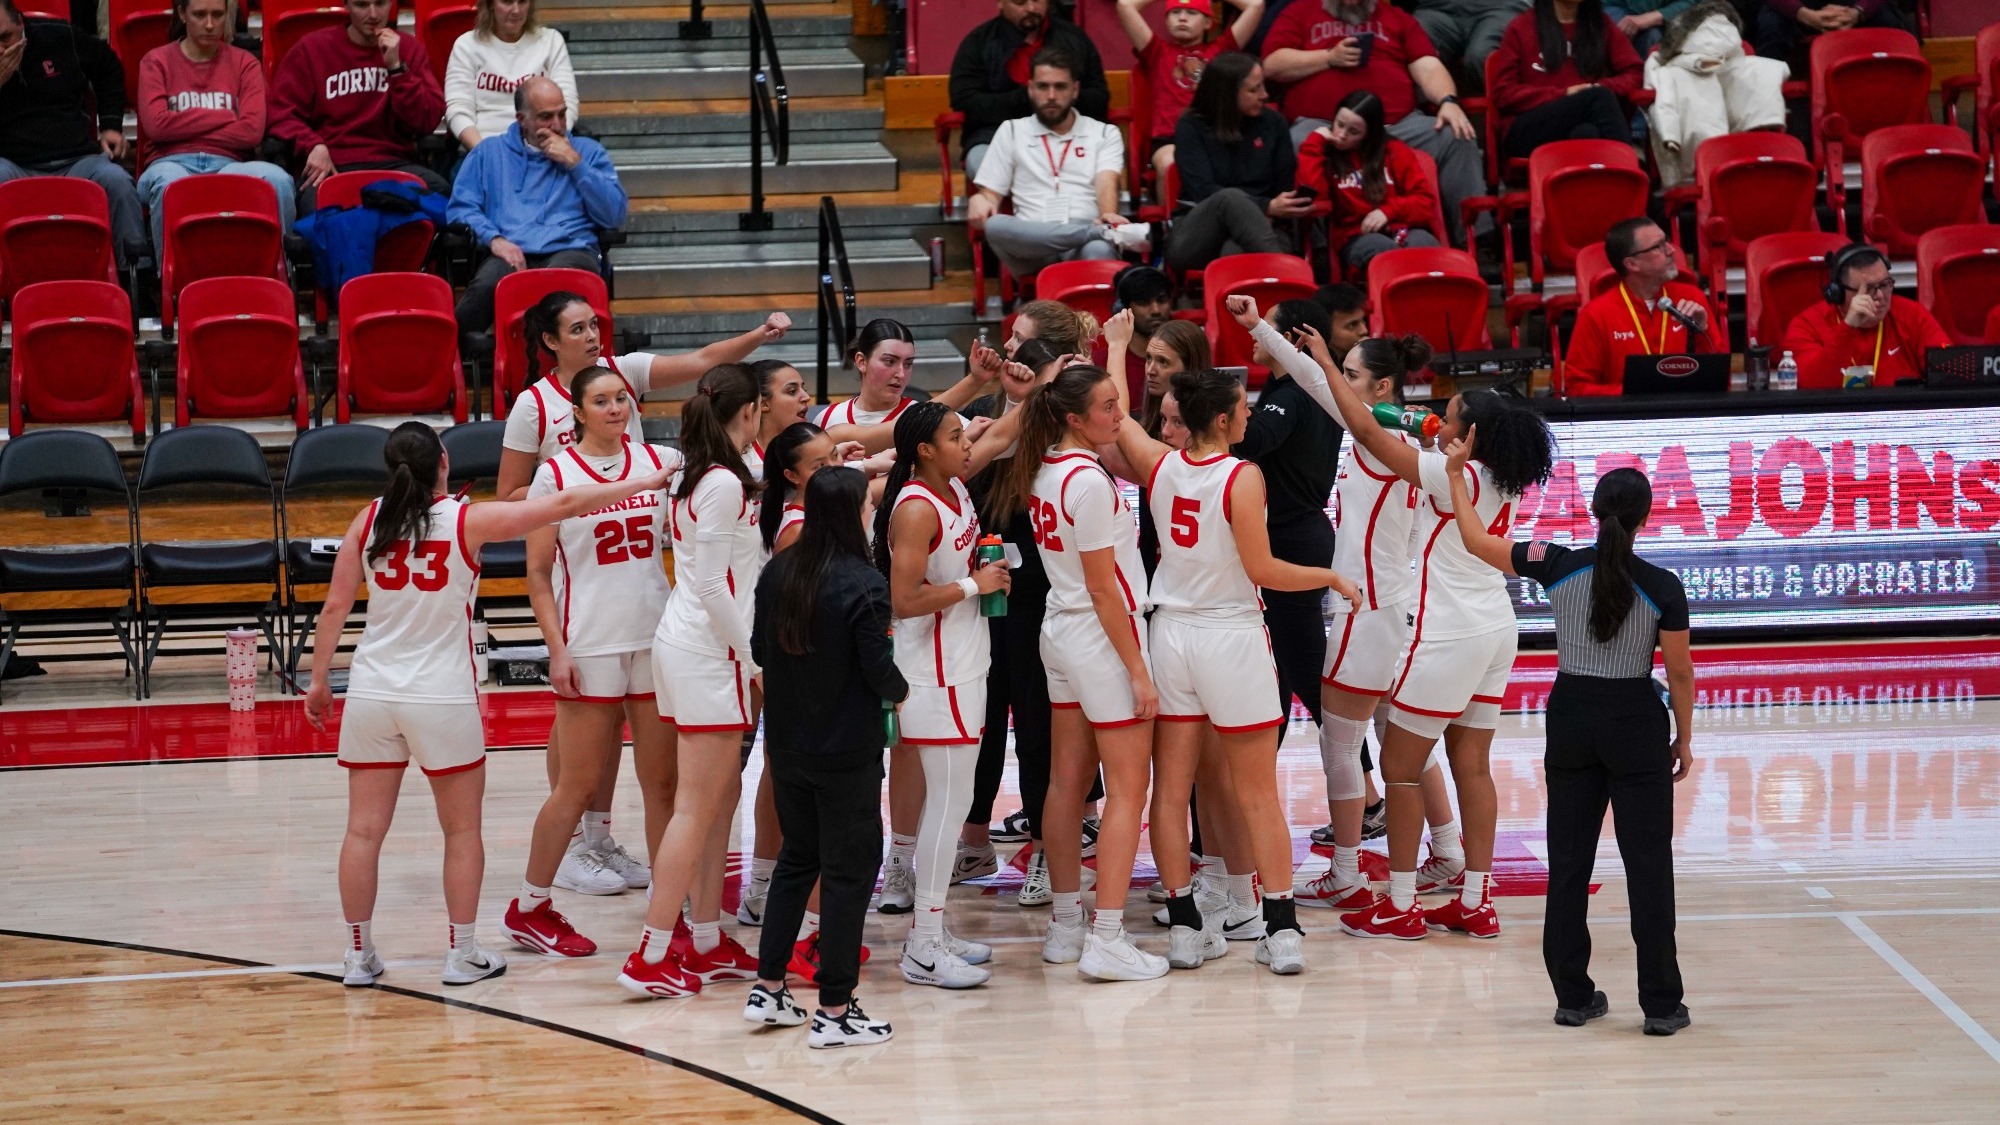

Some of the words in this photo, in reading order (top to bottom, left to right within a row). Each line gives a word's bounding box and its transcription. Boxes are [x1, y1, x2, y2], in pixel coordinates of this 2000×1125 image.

[477, 71, 545, 93] CORN
[170, 91, 238, 113] CORNEL
[1075, 147, 1085, 157] C
[578, 493, 659, 518] RNELL
[1030, 495, 1064, 552] 32
[1171, 495, 1201, 549] 5
[1487, 502, 1511, 539] 4
[594, 515, 654, 565] 25
[374, 540, 451, 592] 33
[1667, 566, 1774, 600] WNED
[1812, 559, 1976, 597] OPERATED
